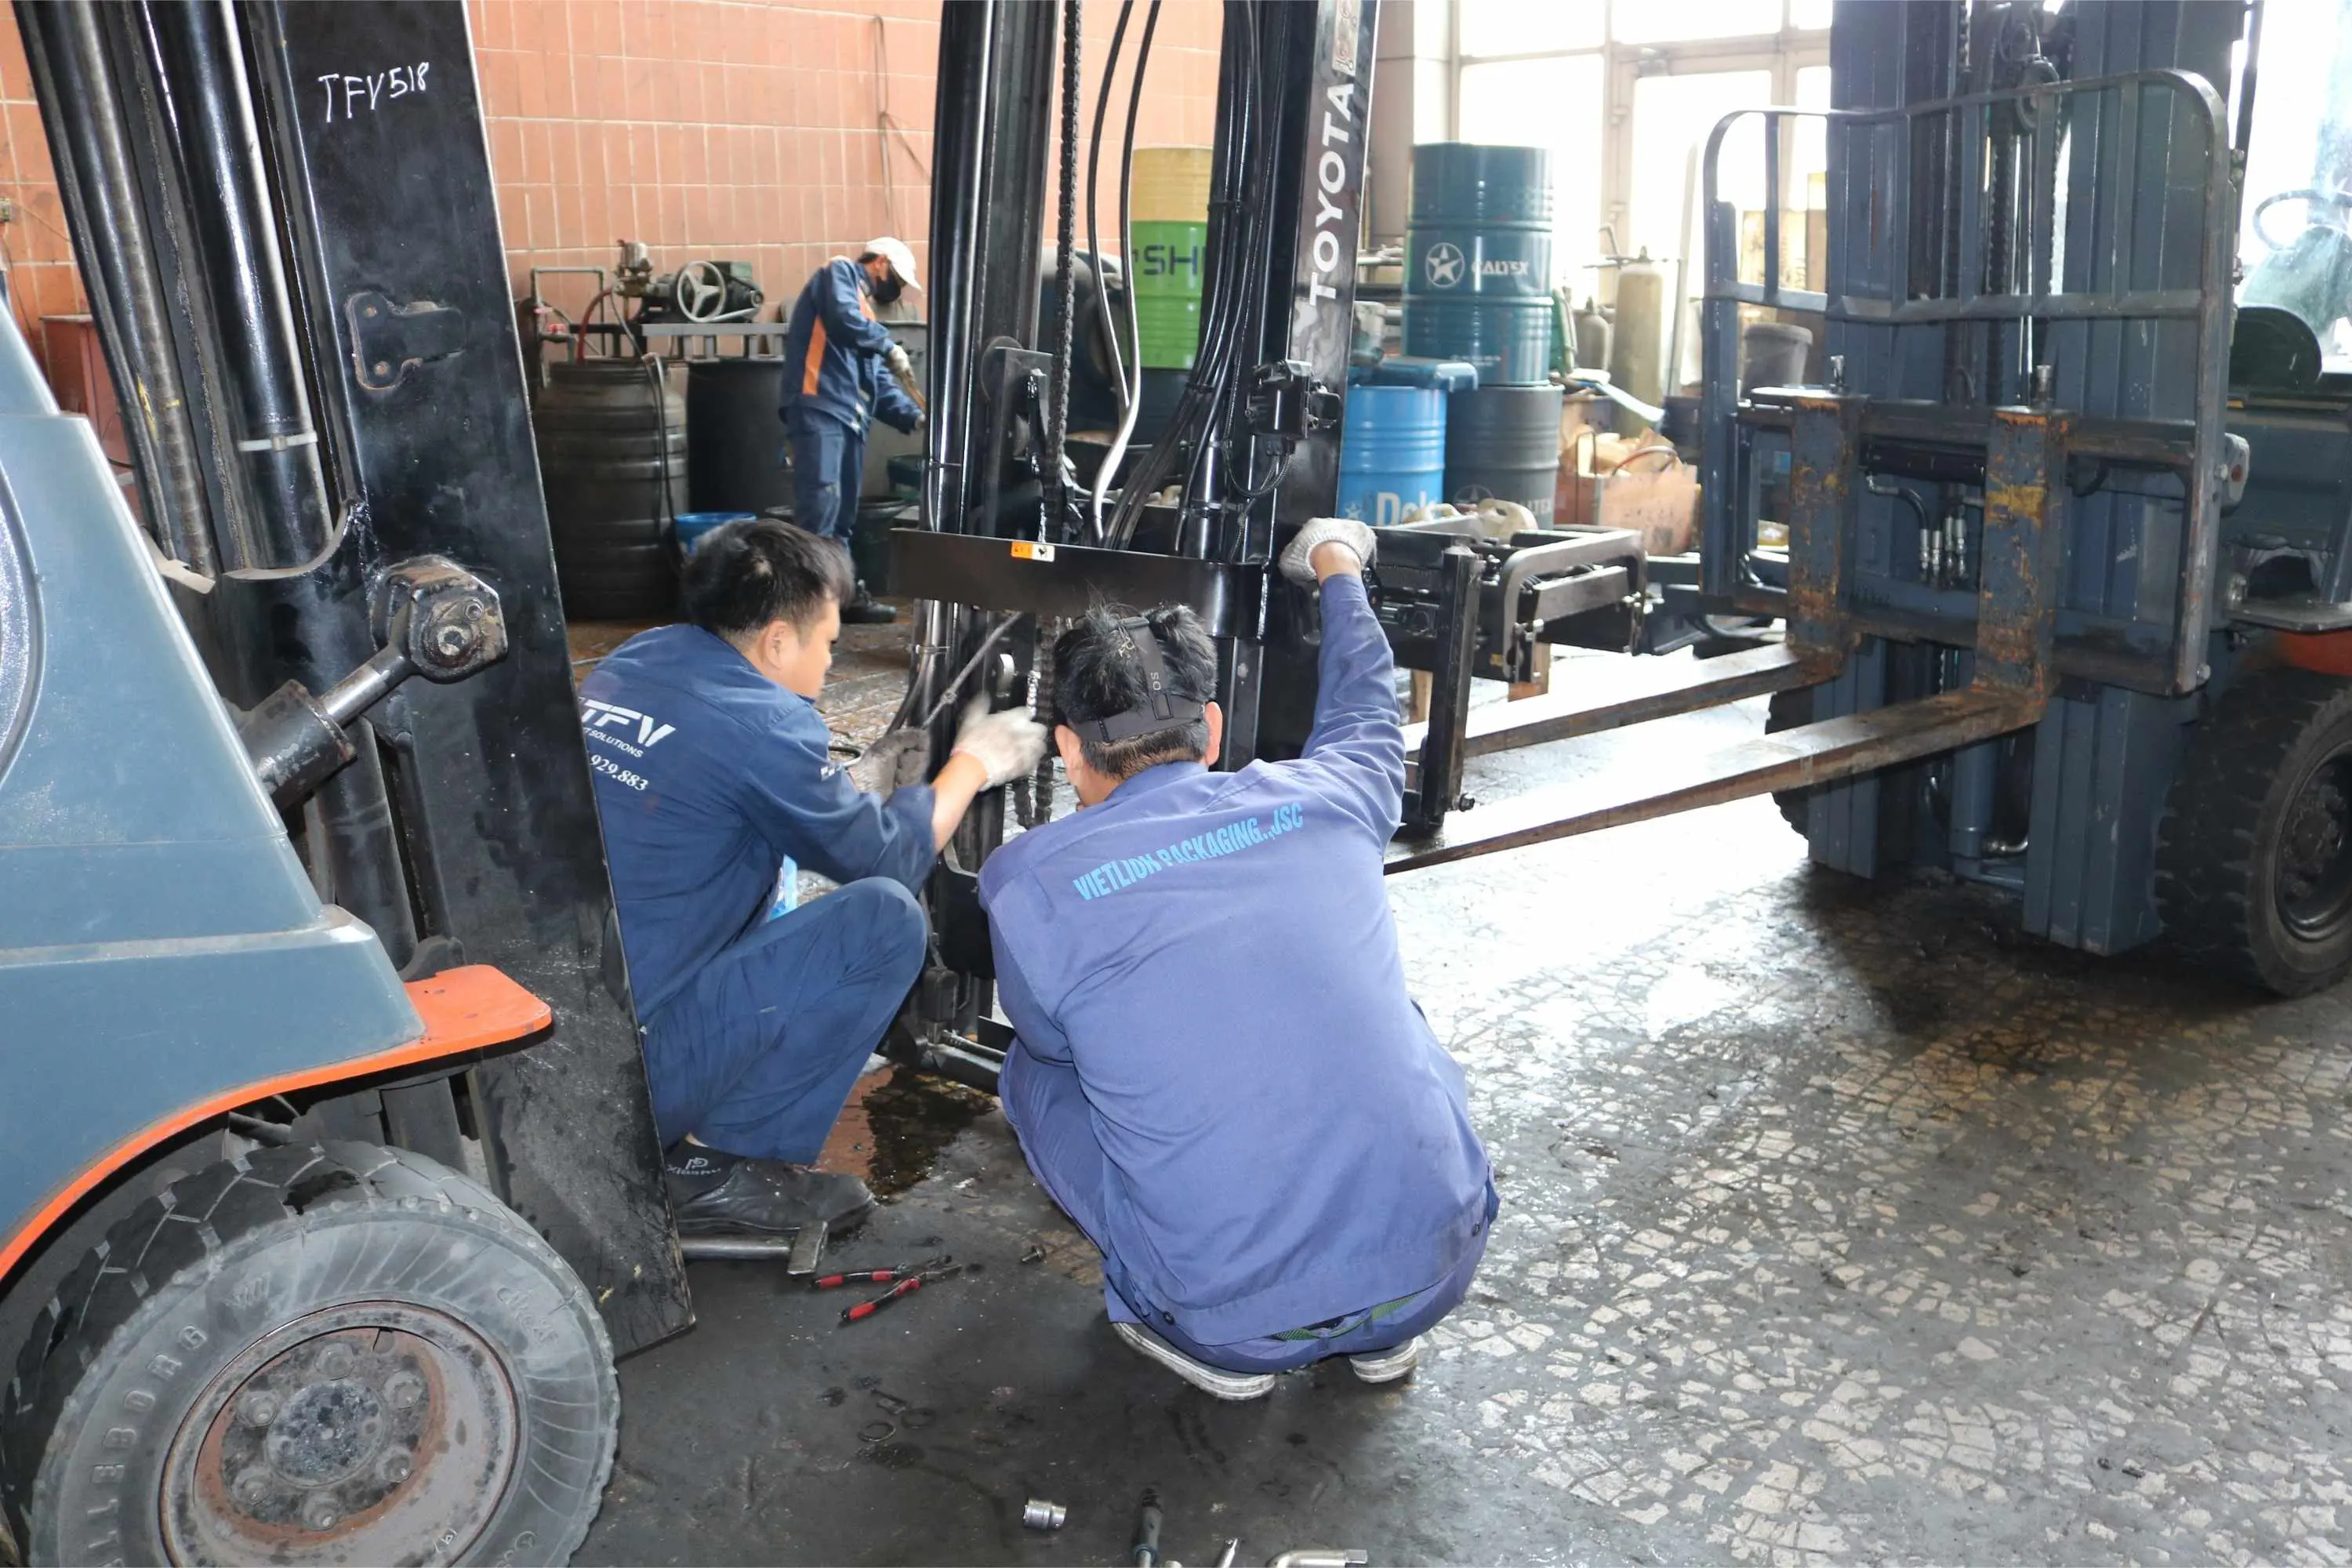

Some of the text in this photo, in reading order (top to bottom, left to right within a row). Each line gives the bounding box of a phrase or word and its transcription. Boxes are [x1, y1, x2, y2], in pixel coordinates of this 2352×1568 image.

[1309, 83, 1354, 307] TOYOTA
[1471, 260, 1529, 274] CALTEX
[581, 699, 676, 747] TFV
[589, 729, 644, 758] SOLUTIONS
[1073, 854, 1163, 901] VIETLION
